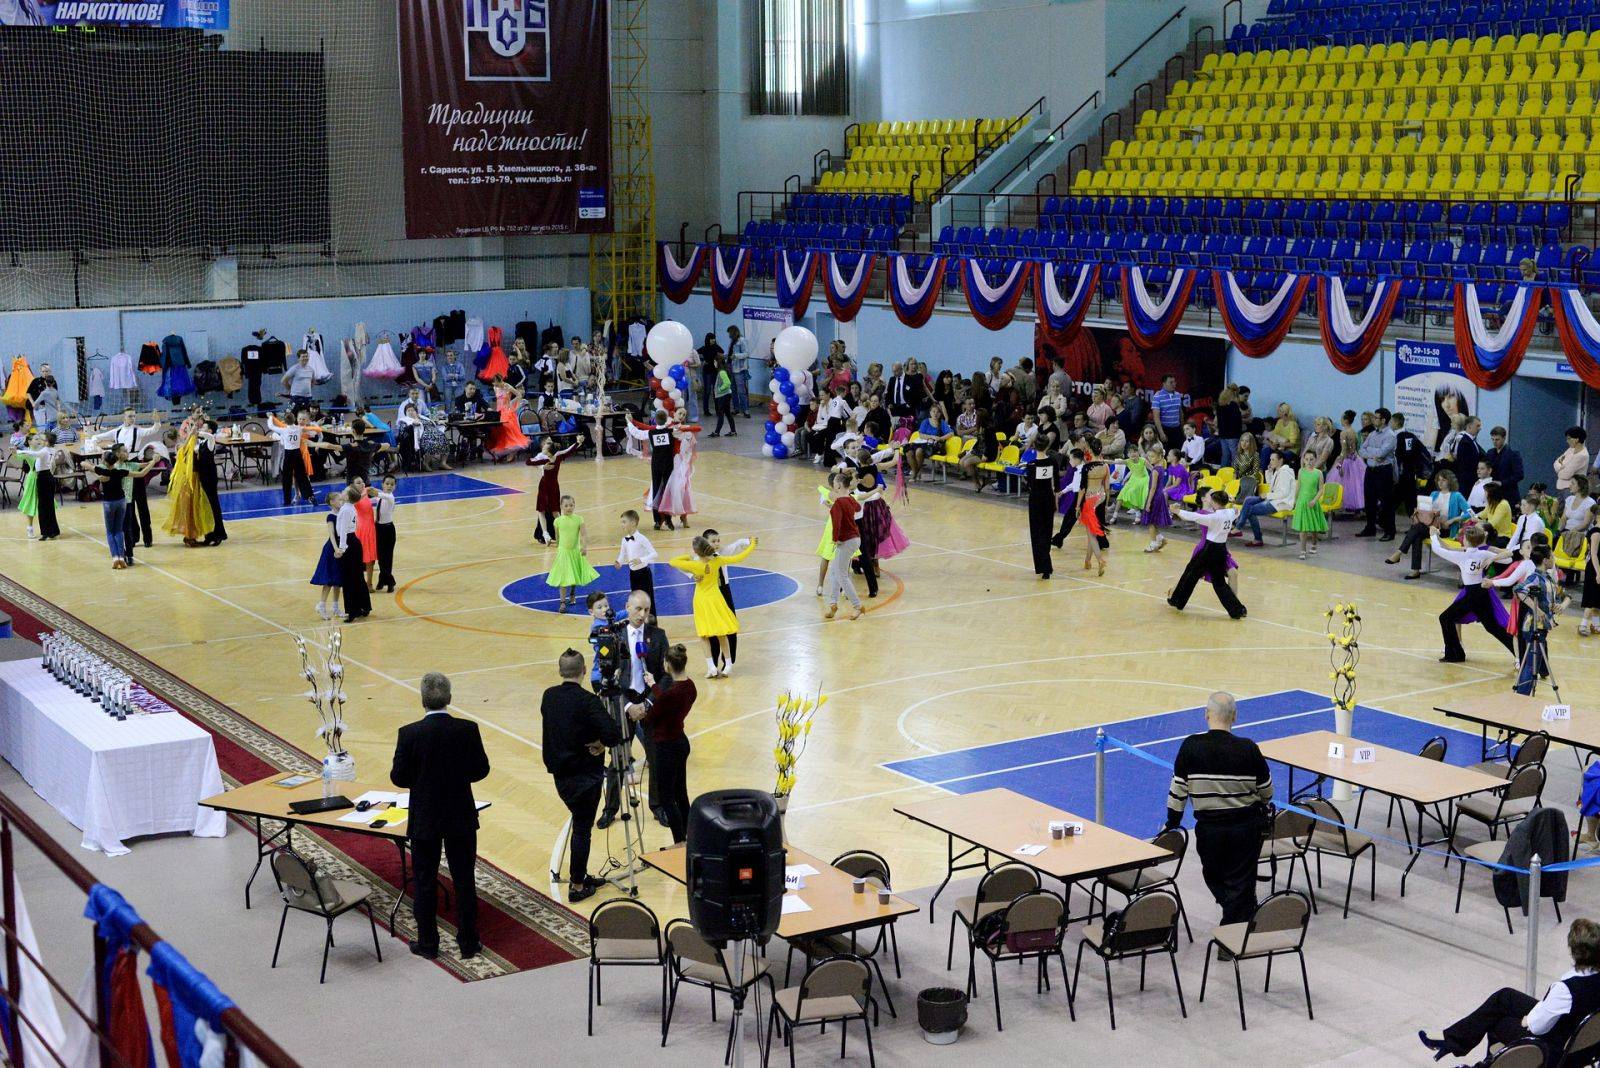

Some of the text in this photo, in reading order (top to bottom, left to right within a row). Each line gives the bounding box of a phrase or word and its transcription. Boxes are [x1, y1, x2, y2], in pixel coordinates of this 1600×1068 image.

[55, 2, 165, 21] НАРКОТИКОВ!
[427, 101, 535, 136] Традиции
[452, 128, 588, 152] надежности!
[429, 166, 470, 175] Саранск,
[498, 164, 563, 174] Хмельницкого,
[289, 434, 298, 442] 70
[656, 435, 667, 444] 52
[1042, 468, 1048, 477] 2
[1469, 561, 1481, 572] 54
[1554, 708, 1567, 717] VIP
[1333, 746, 1338, 755] 1
[1359, 750, 1371, 760] VIP
